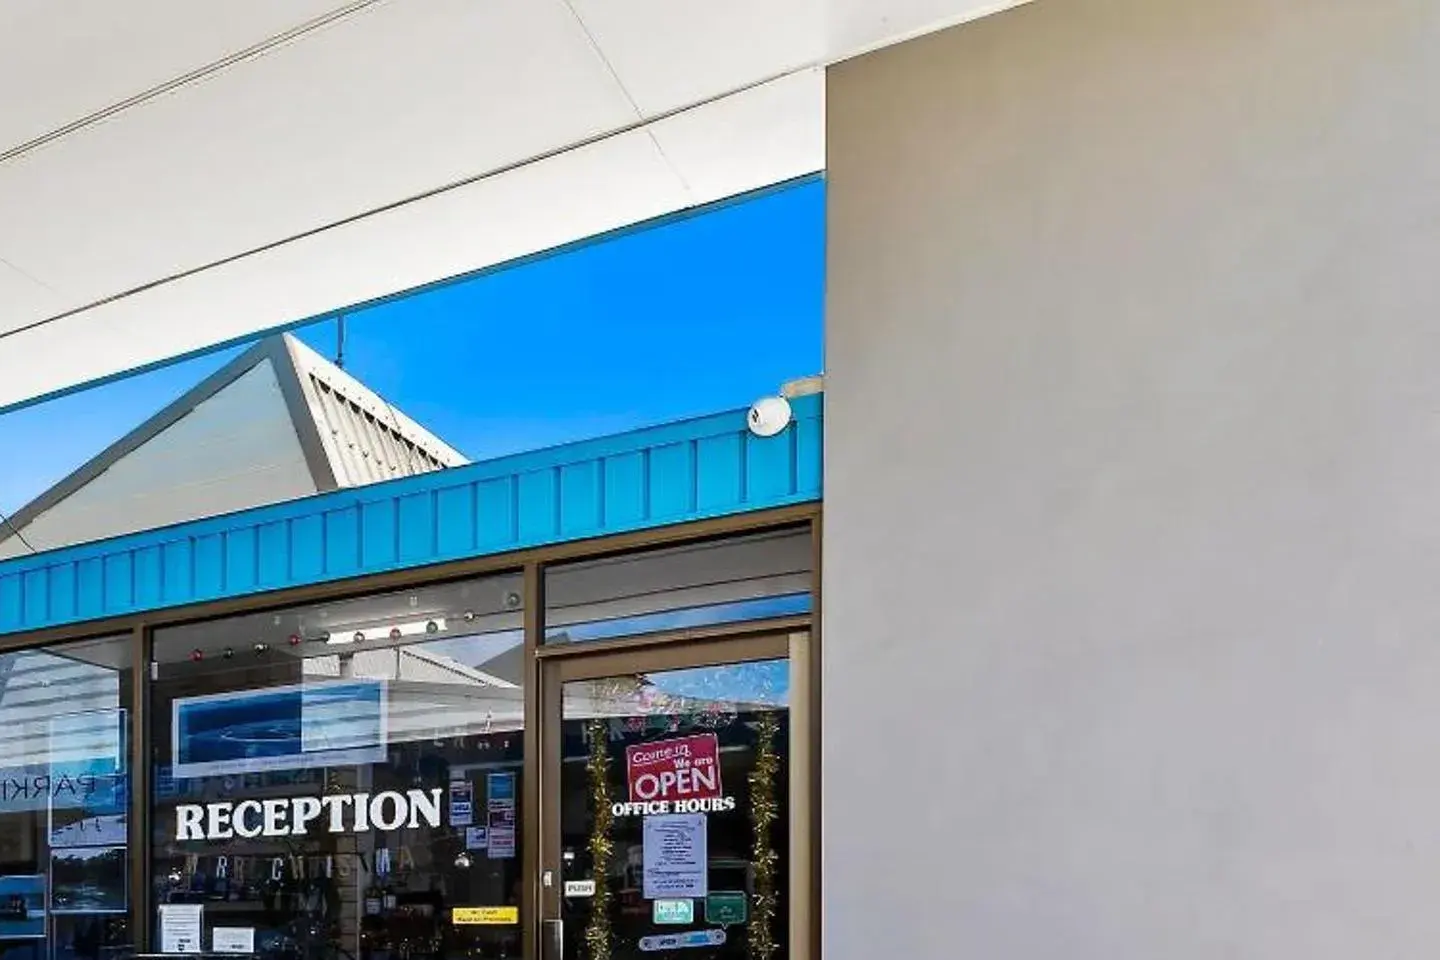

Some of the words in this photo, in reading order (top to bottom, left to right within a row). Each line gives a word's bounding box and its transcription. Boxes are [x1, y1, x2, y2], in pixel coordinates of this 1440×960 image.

[633, 748, 672, 764] Come
[674, 758, 691, 769] We
[694, 757, 713, 766] are
[635, 765, 717, 799] OPEN
[175, 788, 442, 841] RECEPTION
[612, 800, 669, 817] OFFICE
[674, 796, 736, 813] HOURS
